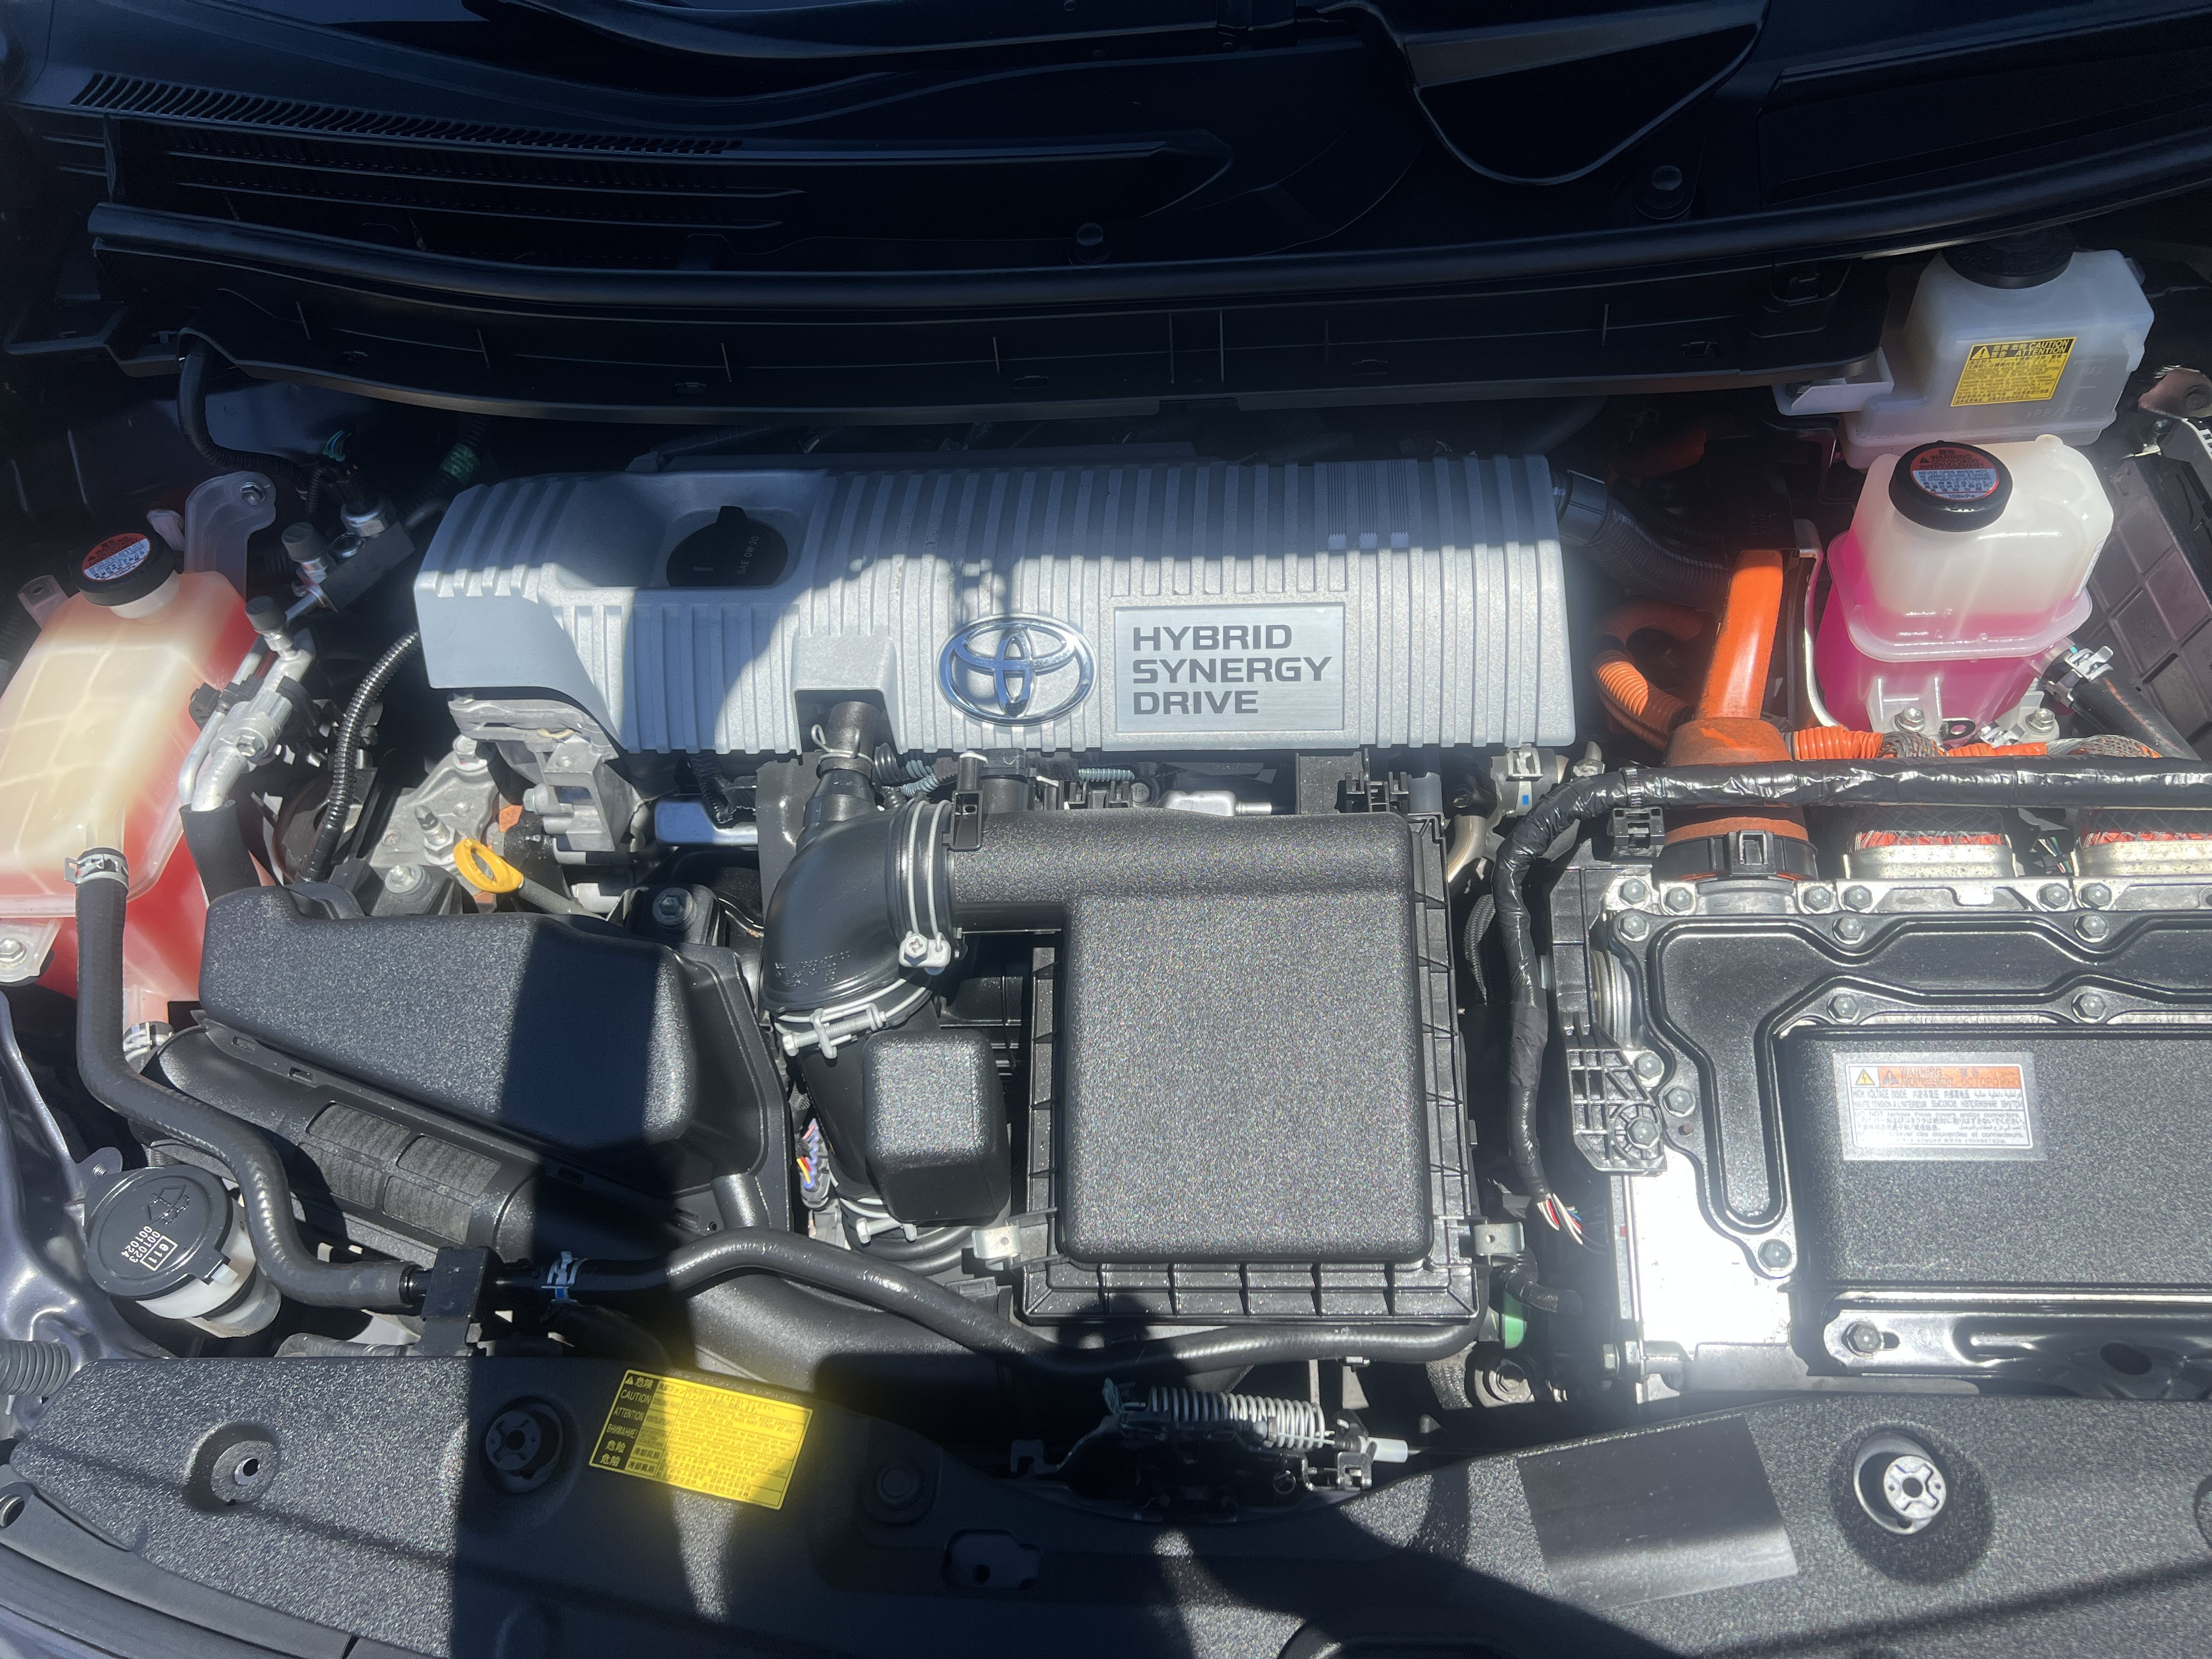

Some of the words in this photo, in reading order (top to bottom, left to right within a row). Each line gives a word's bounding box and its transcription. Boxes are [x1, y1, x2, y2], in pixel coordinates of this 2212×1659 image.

[2015, 347, 2067, 357] ATTENTION
[2029, 340, 2069, 349] CAUTION
[737, 560, 749, 574] SAE
[1133, 625, 1292, 651] HYBRID
[1133, 657, 1333, 684] SYNERGY
[1133, 690, 1259, 715] DRIVE
[1900, 1068, 1942, 1077] WARNING
[1852, 1089, 1864, 1098] HIGH
[1866, 1089, 1889, 1098] VOLTAGE
[1891, 1089, 1908, 1098] INSIDE
[121, 1226, 152, 1258] 001024
[129, 1231, 161, 1263] 001023
[148, 1243, 169, 1263] e11
[619, 1389, 652, 1404] CAUTION
[668, 1401, 681, 1409] FANS
[612, 1406, 645, 1421] ATTENTION
[693, 1413, 716, 1422] IGNITION
[709, 1405, 736, 1415] PERSONAL
[774, 1419, 793, 1428] HANDS
[605, 1423, 639, 1439] ВНИМАНИЕ!
[758, 1422, 775, 1430] START
